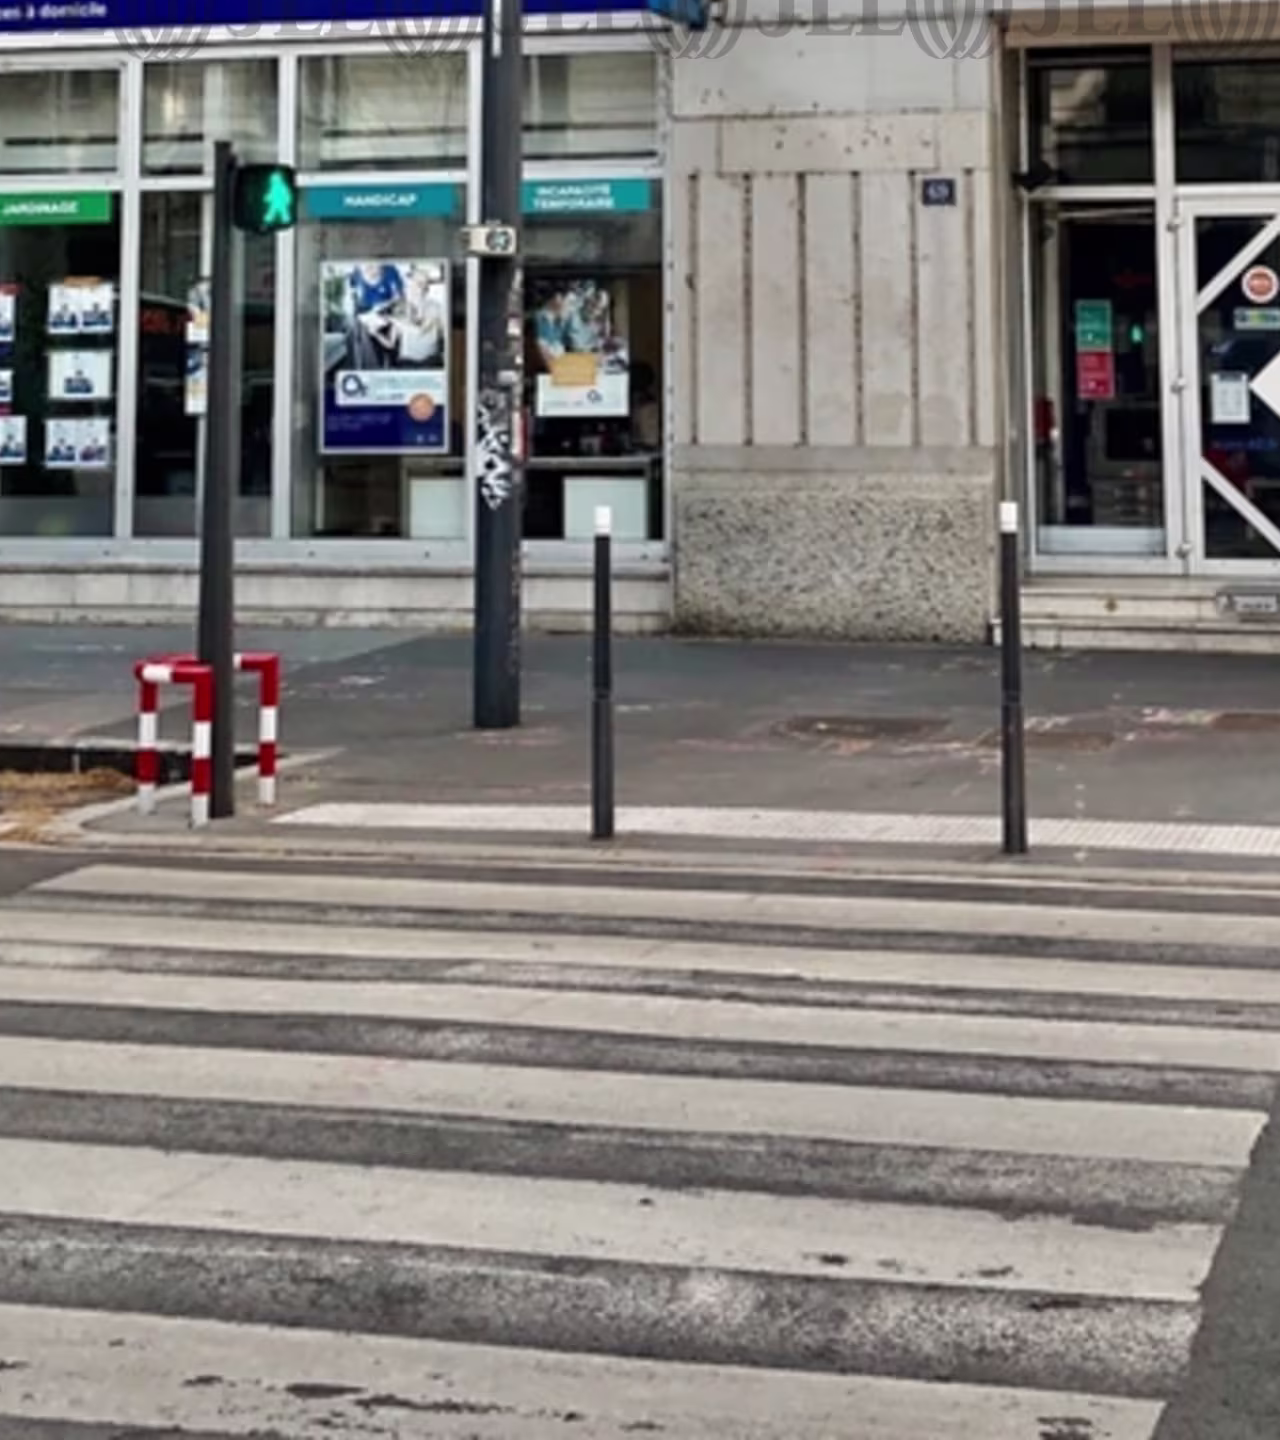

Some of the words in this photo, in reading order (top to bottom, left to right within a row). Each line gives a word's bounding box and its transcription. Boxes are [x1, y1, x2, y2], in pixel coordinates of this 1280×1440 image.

[40, 1, 108, 18] domicile
[343, 193, 417, 207] HANDICAP
[1, 201, 80, 215] JARDINAGE
